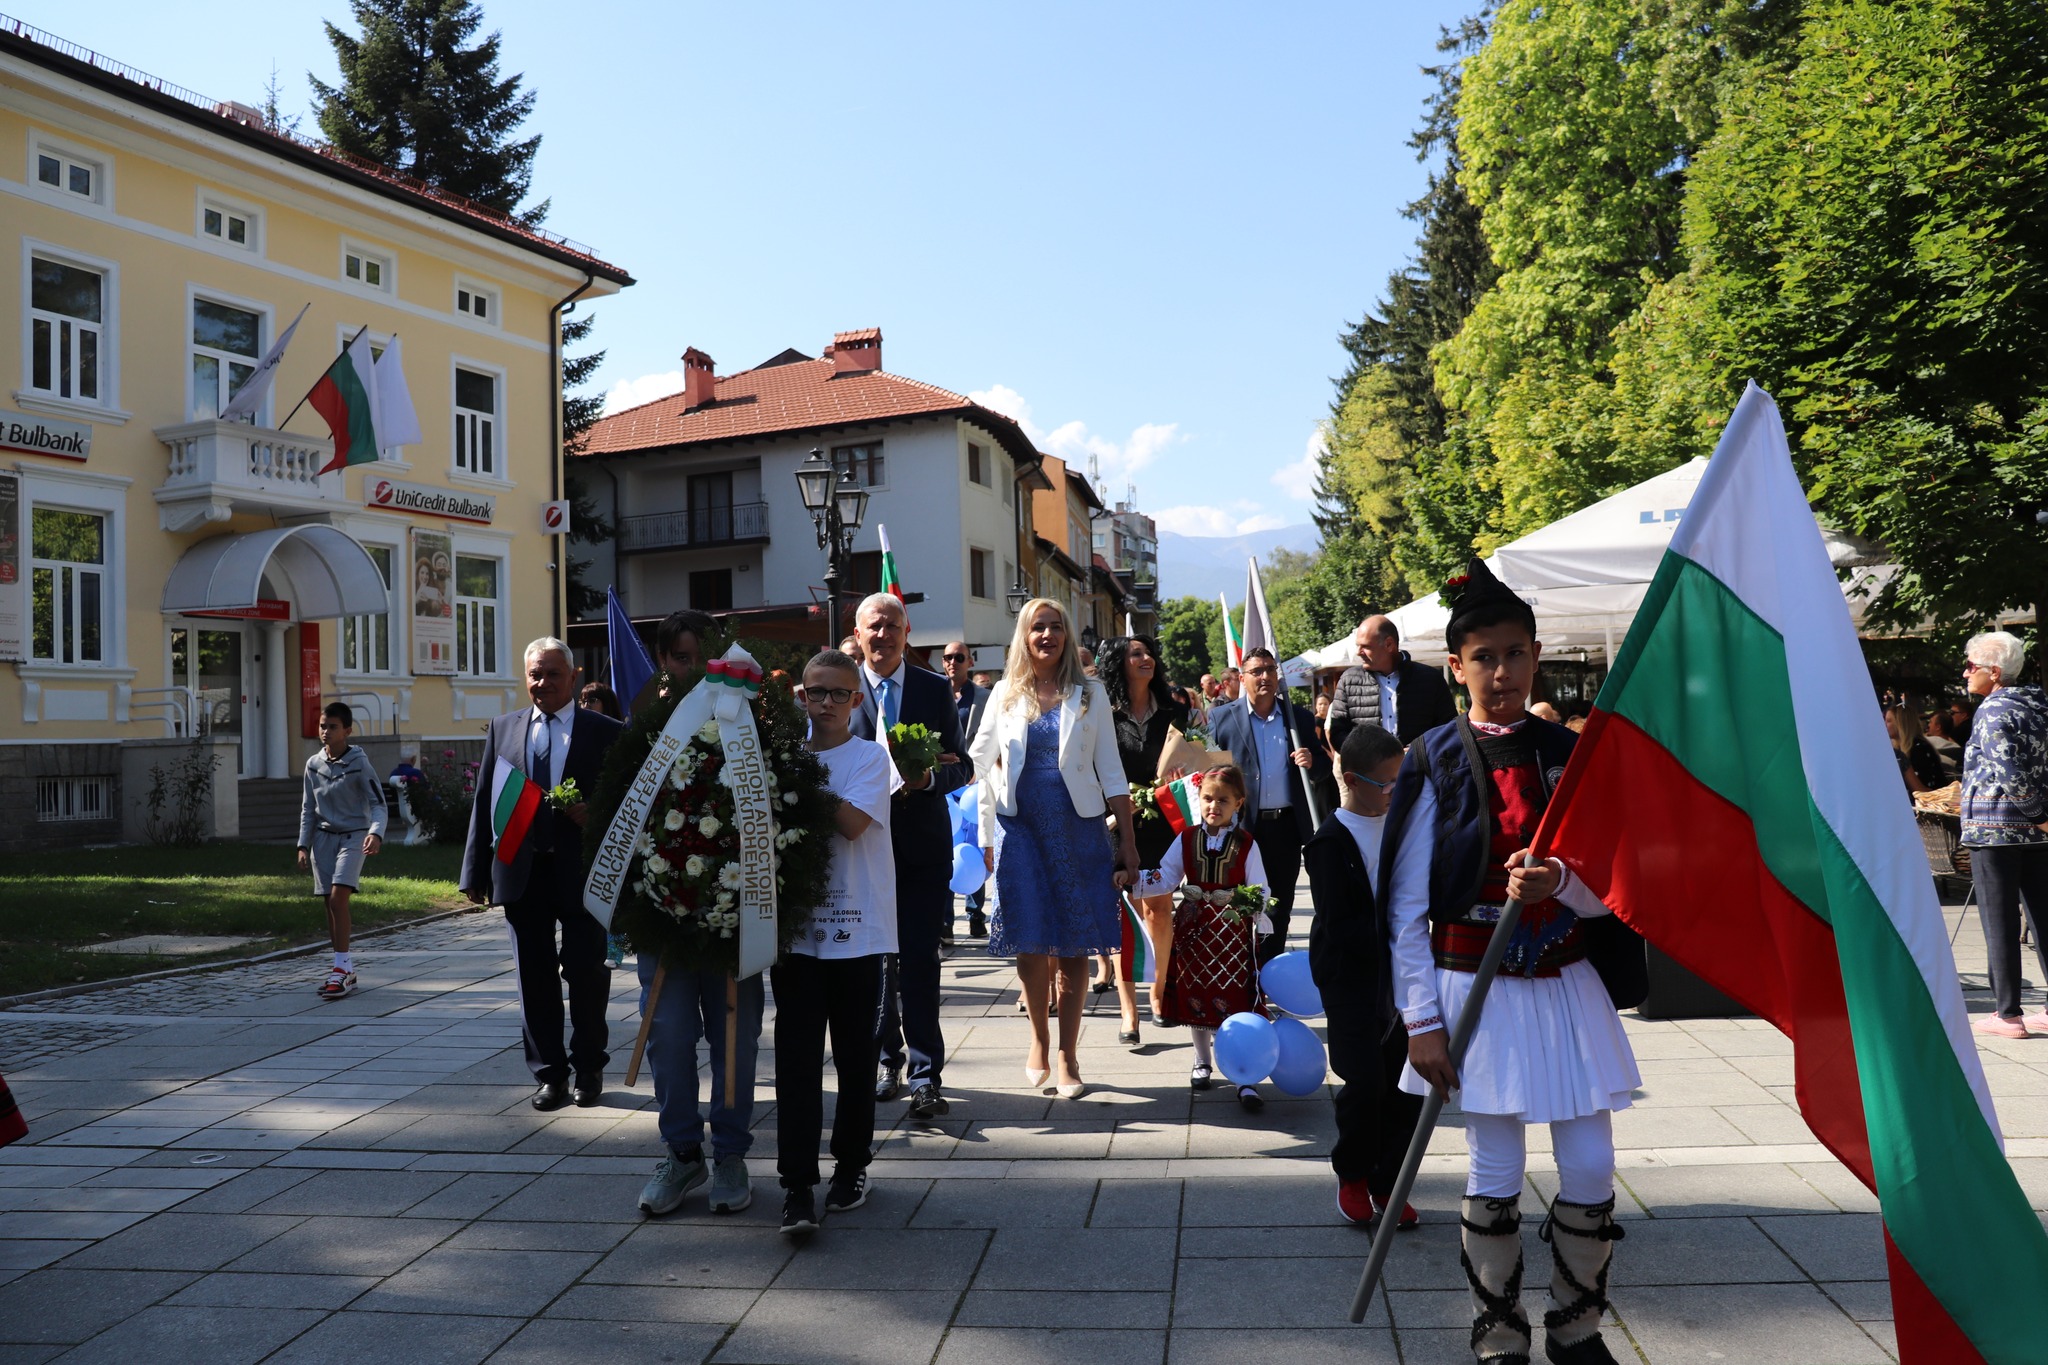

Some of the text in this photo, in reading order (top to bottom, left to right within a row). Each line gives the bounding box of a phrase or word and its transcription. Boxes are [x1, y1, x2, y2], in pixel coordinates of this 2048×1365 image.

[8, 423, 84, 453] Bulbank
[395, 489, 492, 519] UniCredit Bulbank
[588, 871, 602, 898] ПП
[597, 795, 637, 869] ПАРТИЯ
[632, 748, 663, 794] ГЕРБ
[600, 736, 681, 905] КРАСИМИР ГЕРЧЕВ
[727, 740, 759, 907] С ПРЕКЛОНЕНИЕ!
[737, 724, 774, 921] ПОКЛОН АПОСТОЛЕ!
